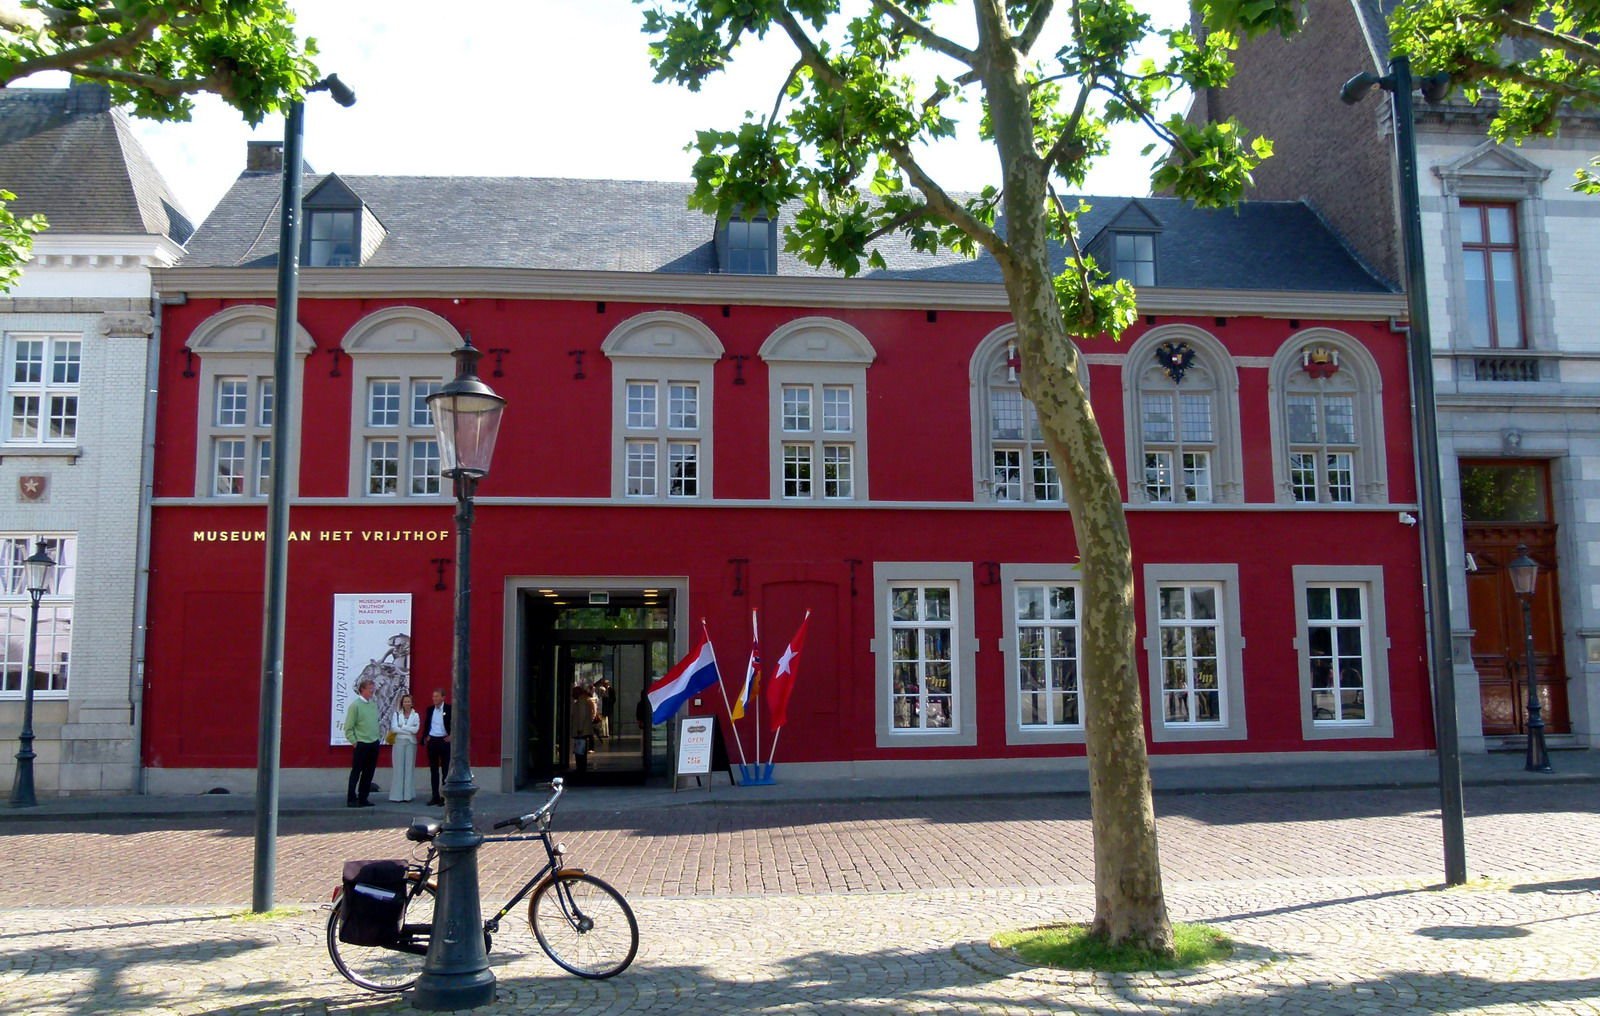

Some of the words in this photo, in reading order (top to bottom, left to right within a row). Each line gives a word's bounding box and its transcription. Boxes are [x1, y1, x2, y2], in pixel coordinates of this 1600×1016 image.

[194, 530, 265, 541] MUSEUM
[319, 530, 352, 541] HET
[362, 530, 449, 541] VRIJTHOF
[336, 620, 349, 680] Maastrichts
[336, 682, 348, 714] Zilver
